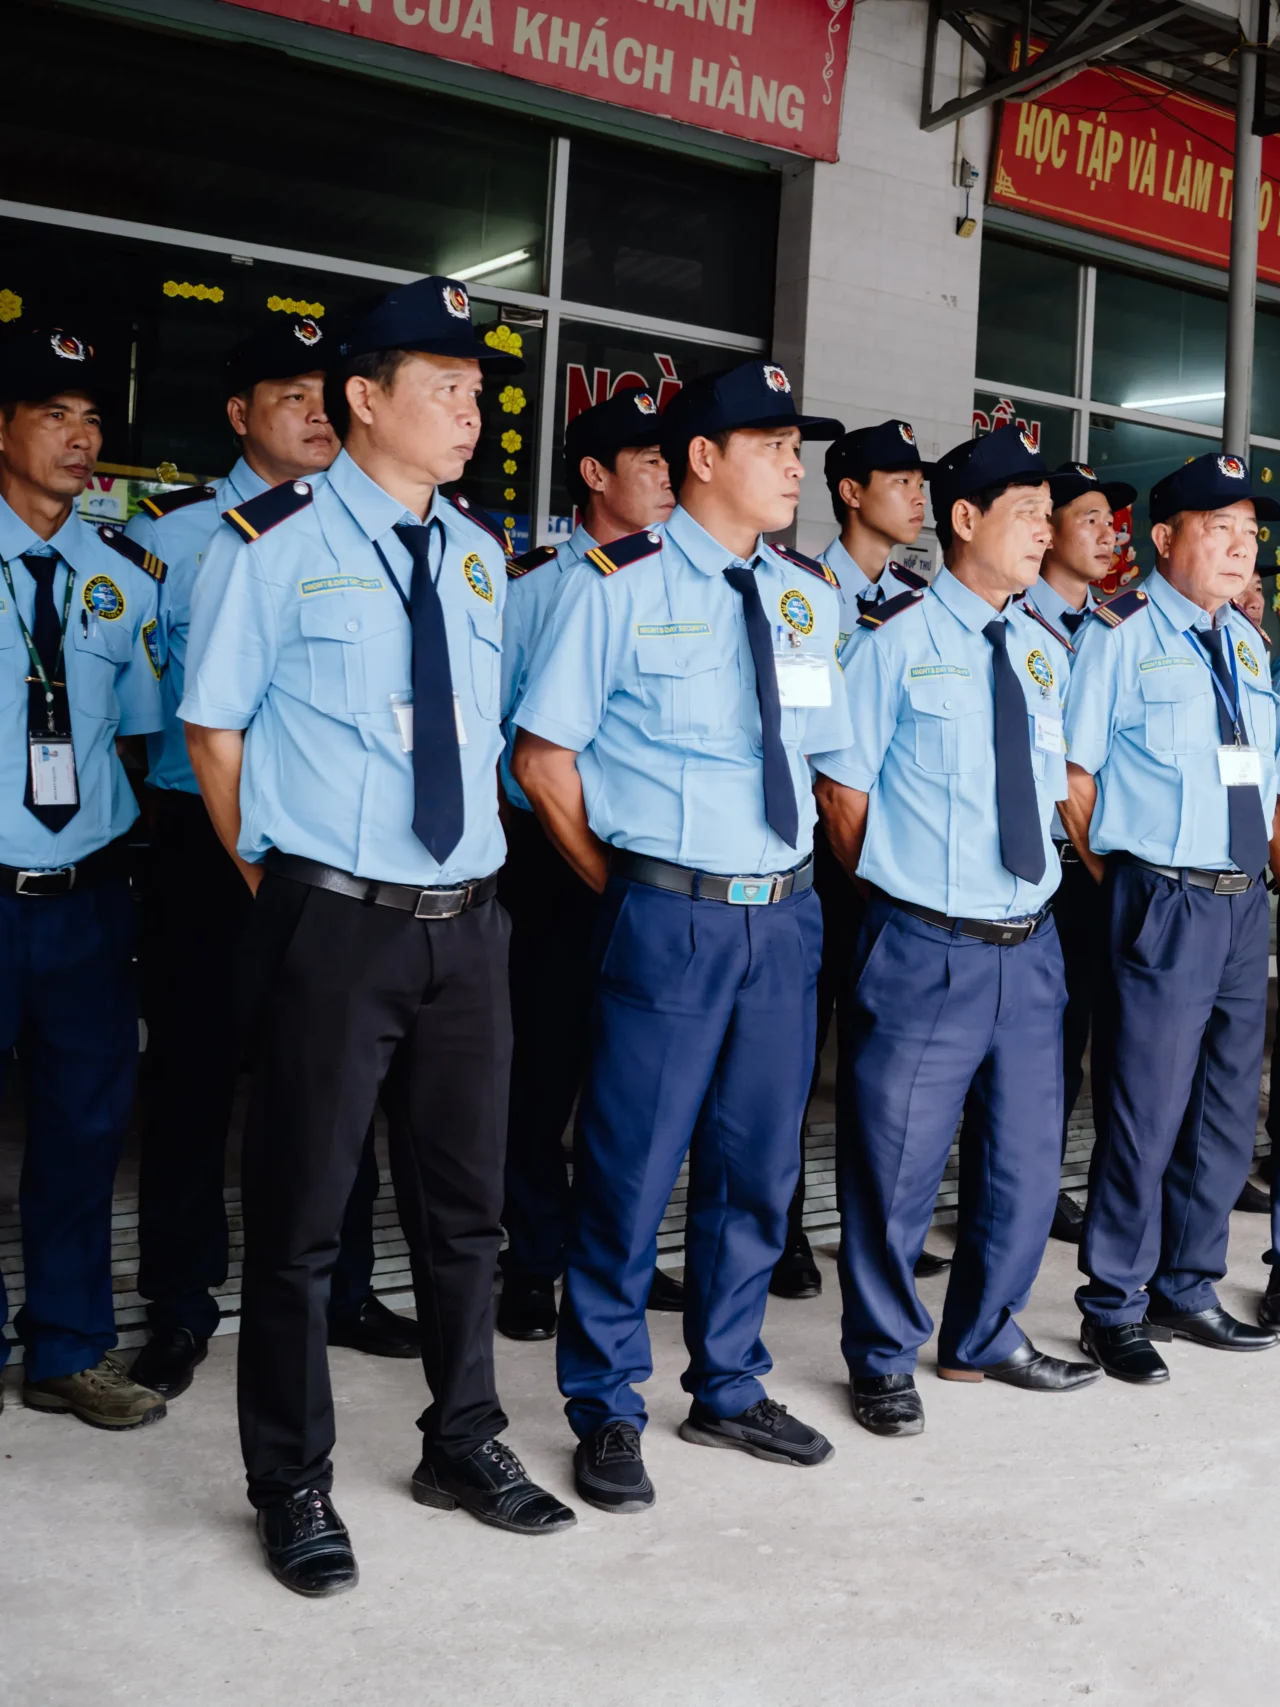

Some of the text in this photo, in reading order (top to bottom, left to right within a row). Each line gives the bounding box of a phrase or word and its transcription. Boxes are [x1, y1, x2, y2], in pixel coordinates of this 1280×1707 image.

[512, 7, 675, 95] KHÁCH
[689, 55, 806, 132] HÀNG
[1015, 102, 1070, 175] HỌC
[1075, 111, 1124, 191] TẬP
[1128, 127, 1158, 197] VÀ
[1162, 140, 1214, 213] LÀM
[1218, 166, 1273, 232] TO
